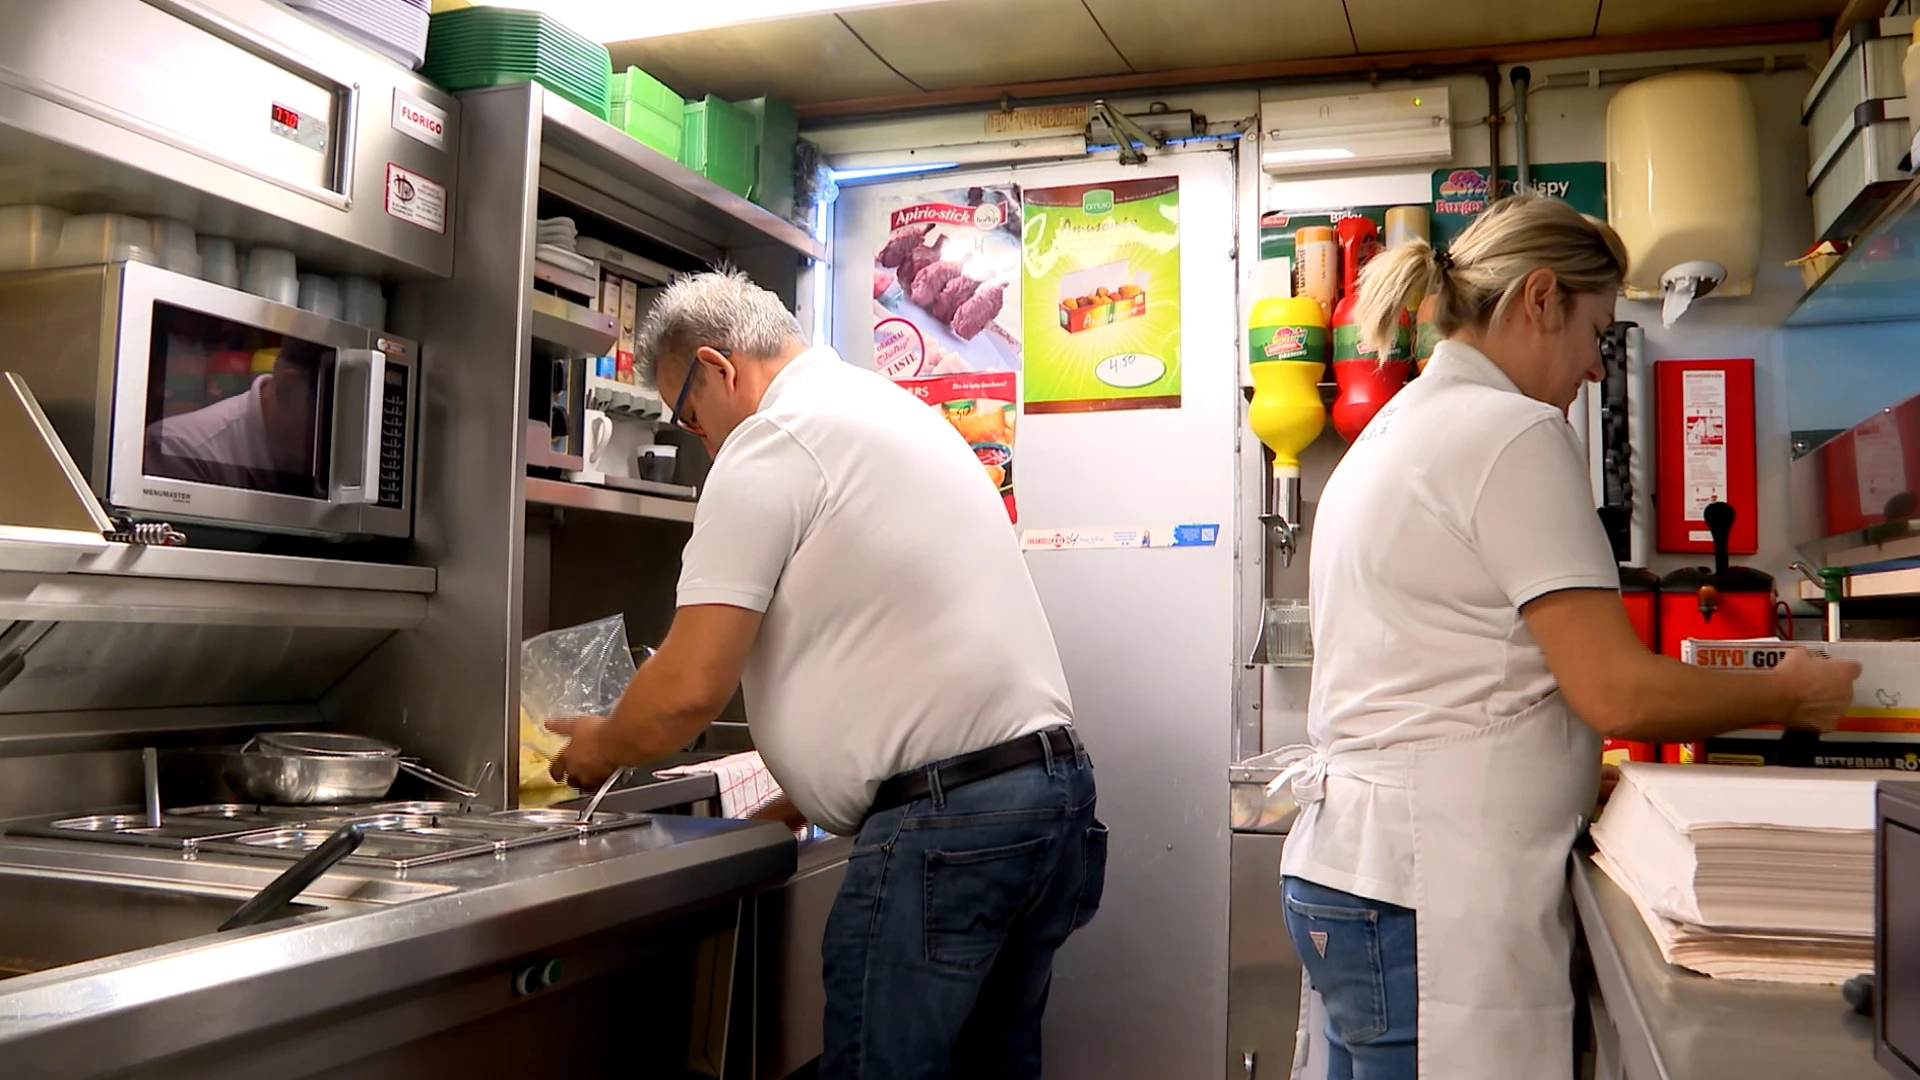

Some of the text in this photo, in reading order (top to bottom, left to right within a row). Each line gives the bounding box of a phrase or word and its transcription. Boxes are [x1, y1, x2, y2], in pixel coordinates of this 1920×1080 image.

[401, 106, 442, 135] FLORIGO
[1029, 107, 1082, 129] VERBODEN
[1085, 202, 1111, 210] amuso
[1435, 199, 1484, 216] Burger
[895, 206, 971, 225] Apirio-stick
[876, 330, 905, 352] ORIGINAL
[886, 351, 917, 377] TASTE
[142, 488, 191, 500] MENUMASTER
[1696, 649, 1744, 667] SITO
[1814, 756, 1920, 771] BITTERBAL RO
